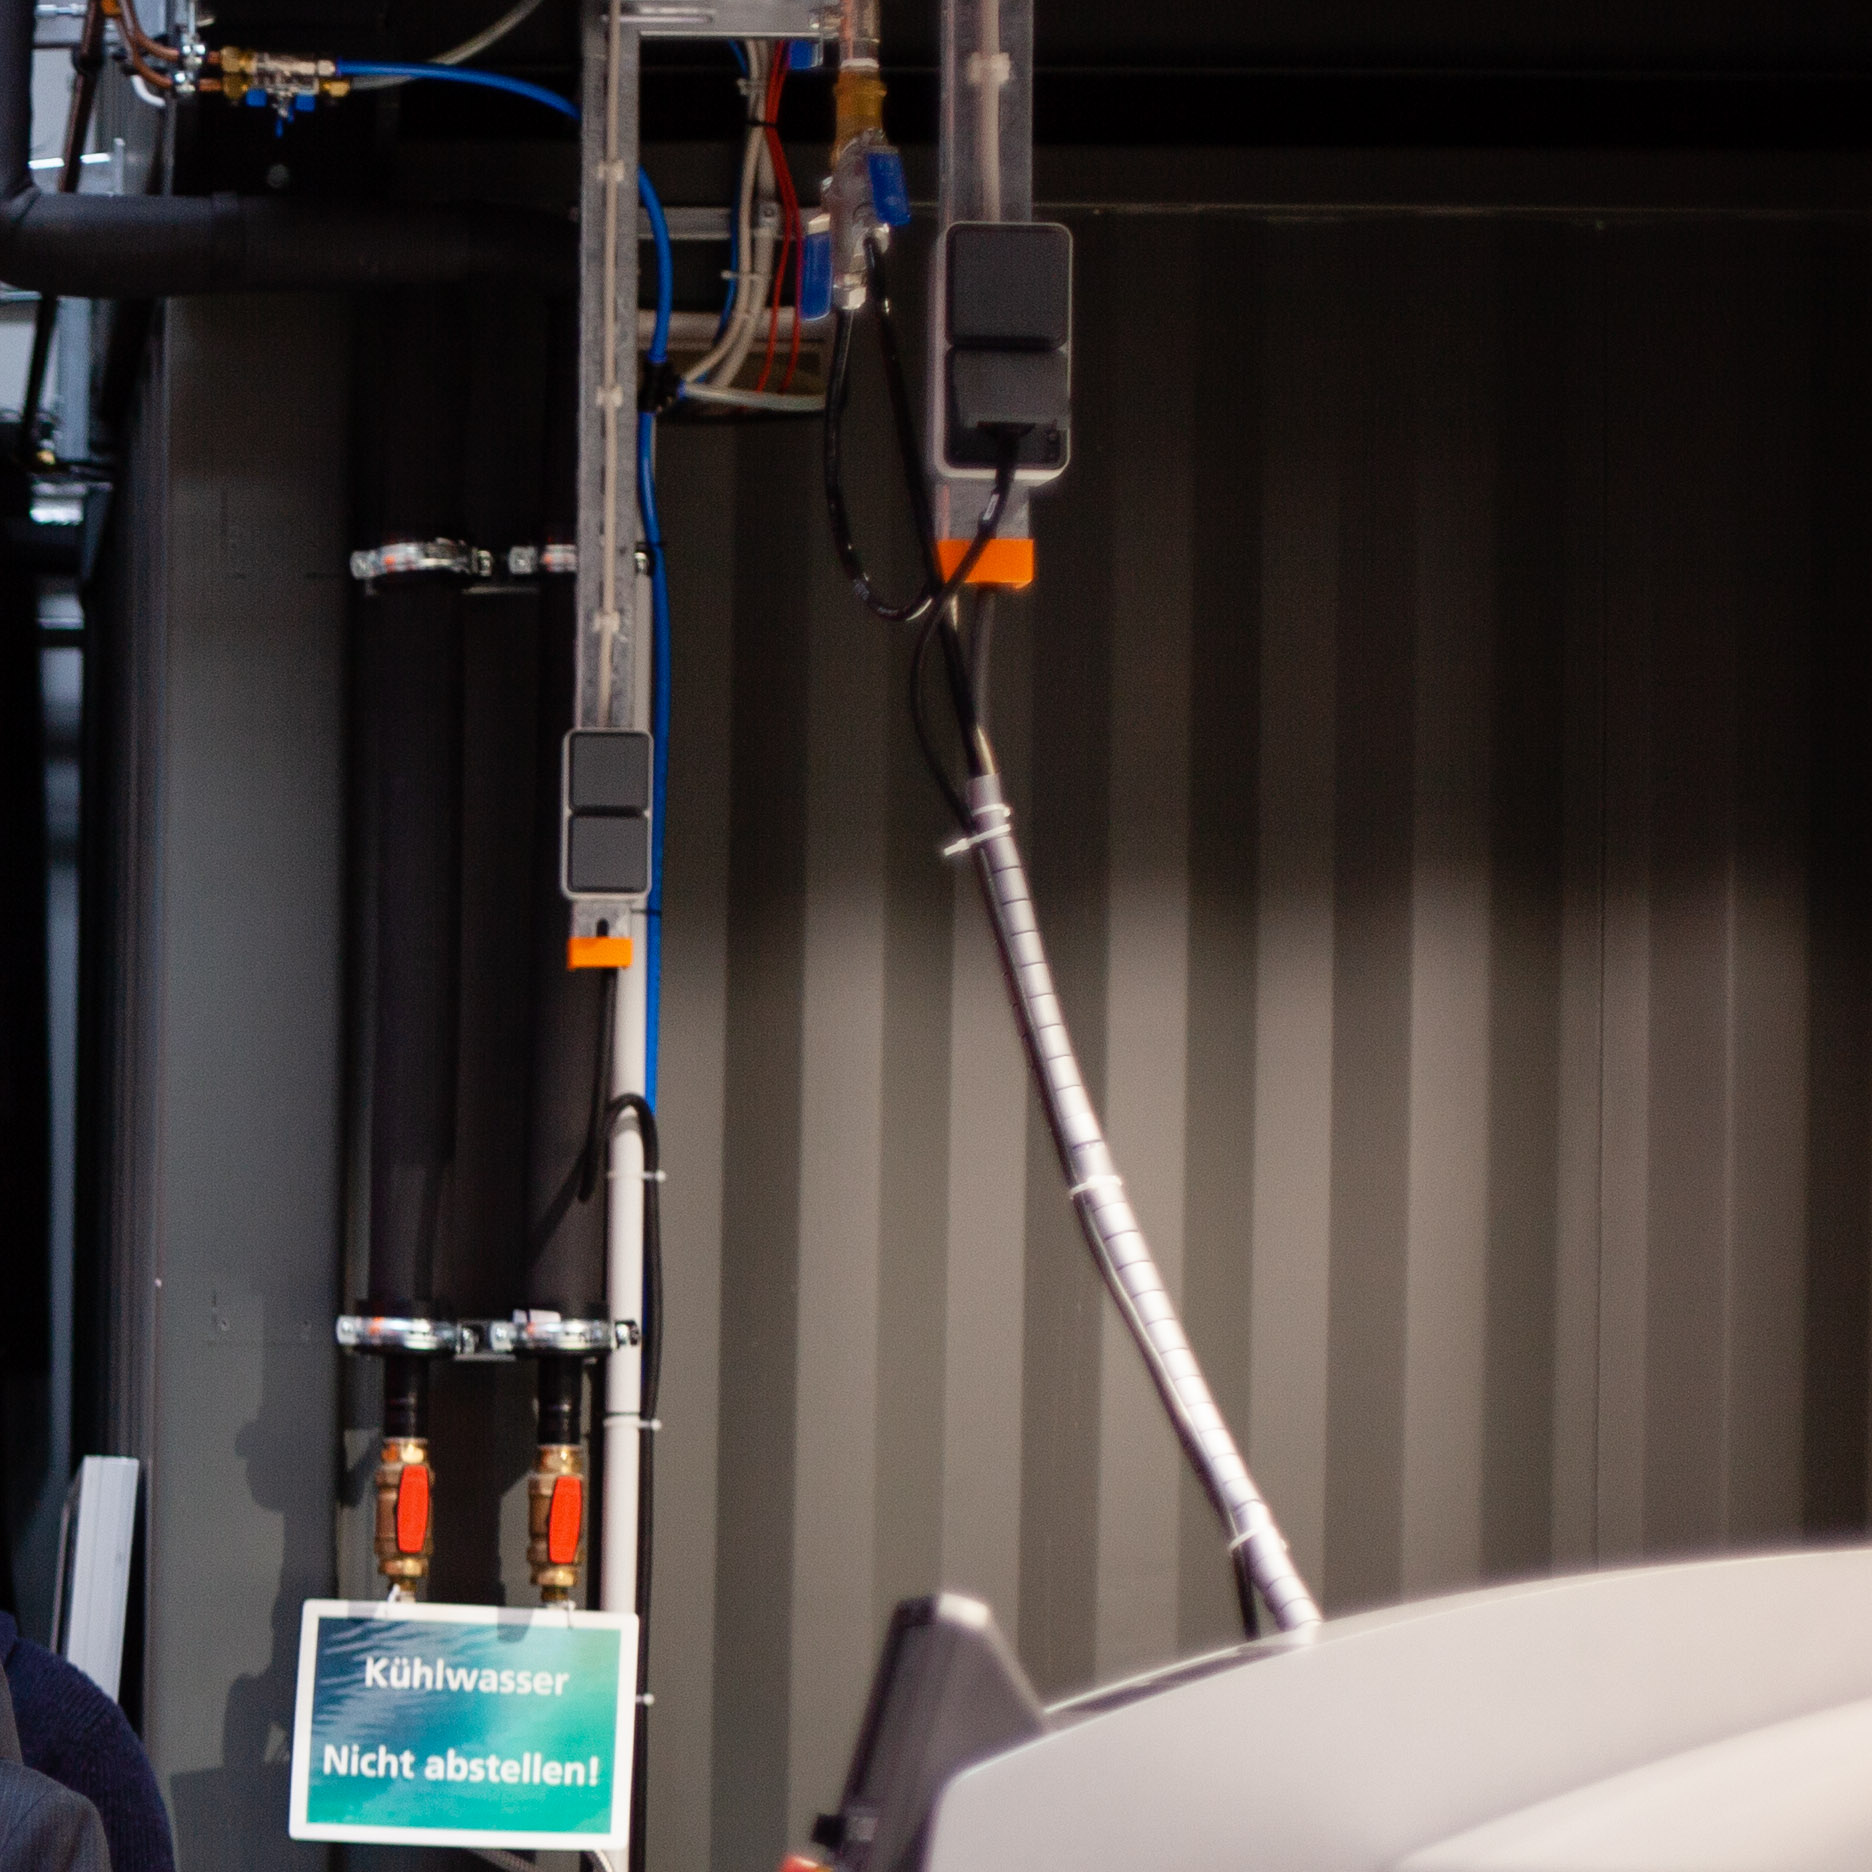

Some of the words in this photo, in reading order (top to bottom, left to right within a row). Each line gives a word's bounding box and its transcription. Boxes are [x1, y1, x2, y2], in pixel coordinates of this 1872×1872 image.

[364, 1655, 570, 1696] Kühlwasser
[322, 1743, 416, 1779] Nicht
[424, 1748, 600, 1787] abstellen!
